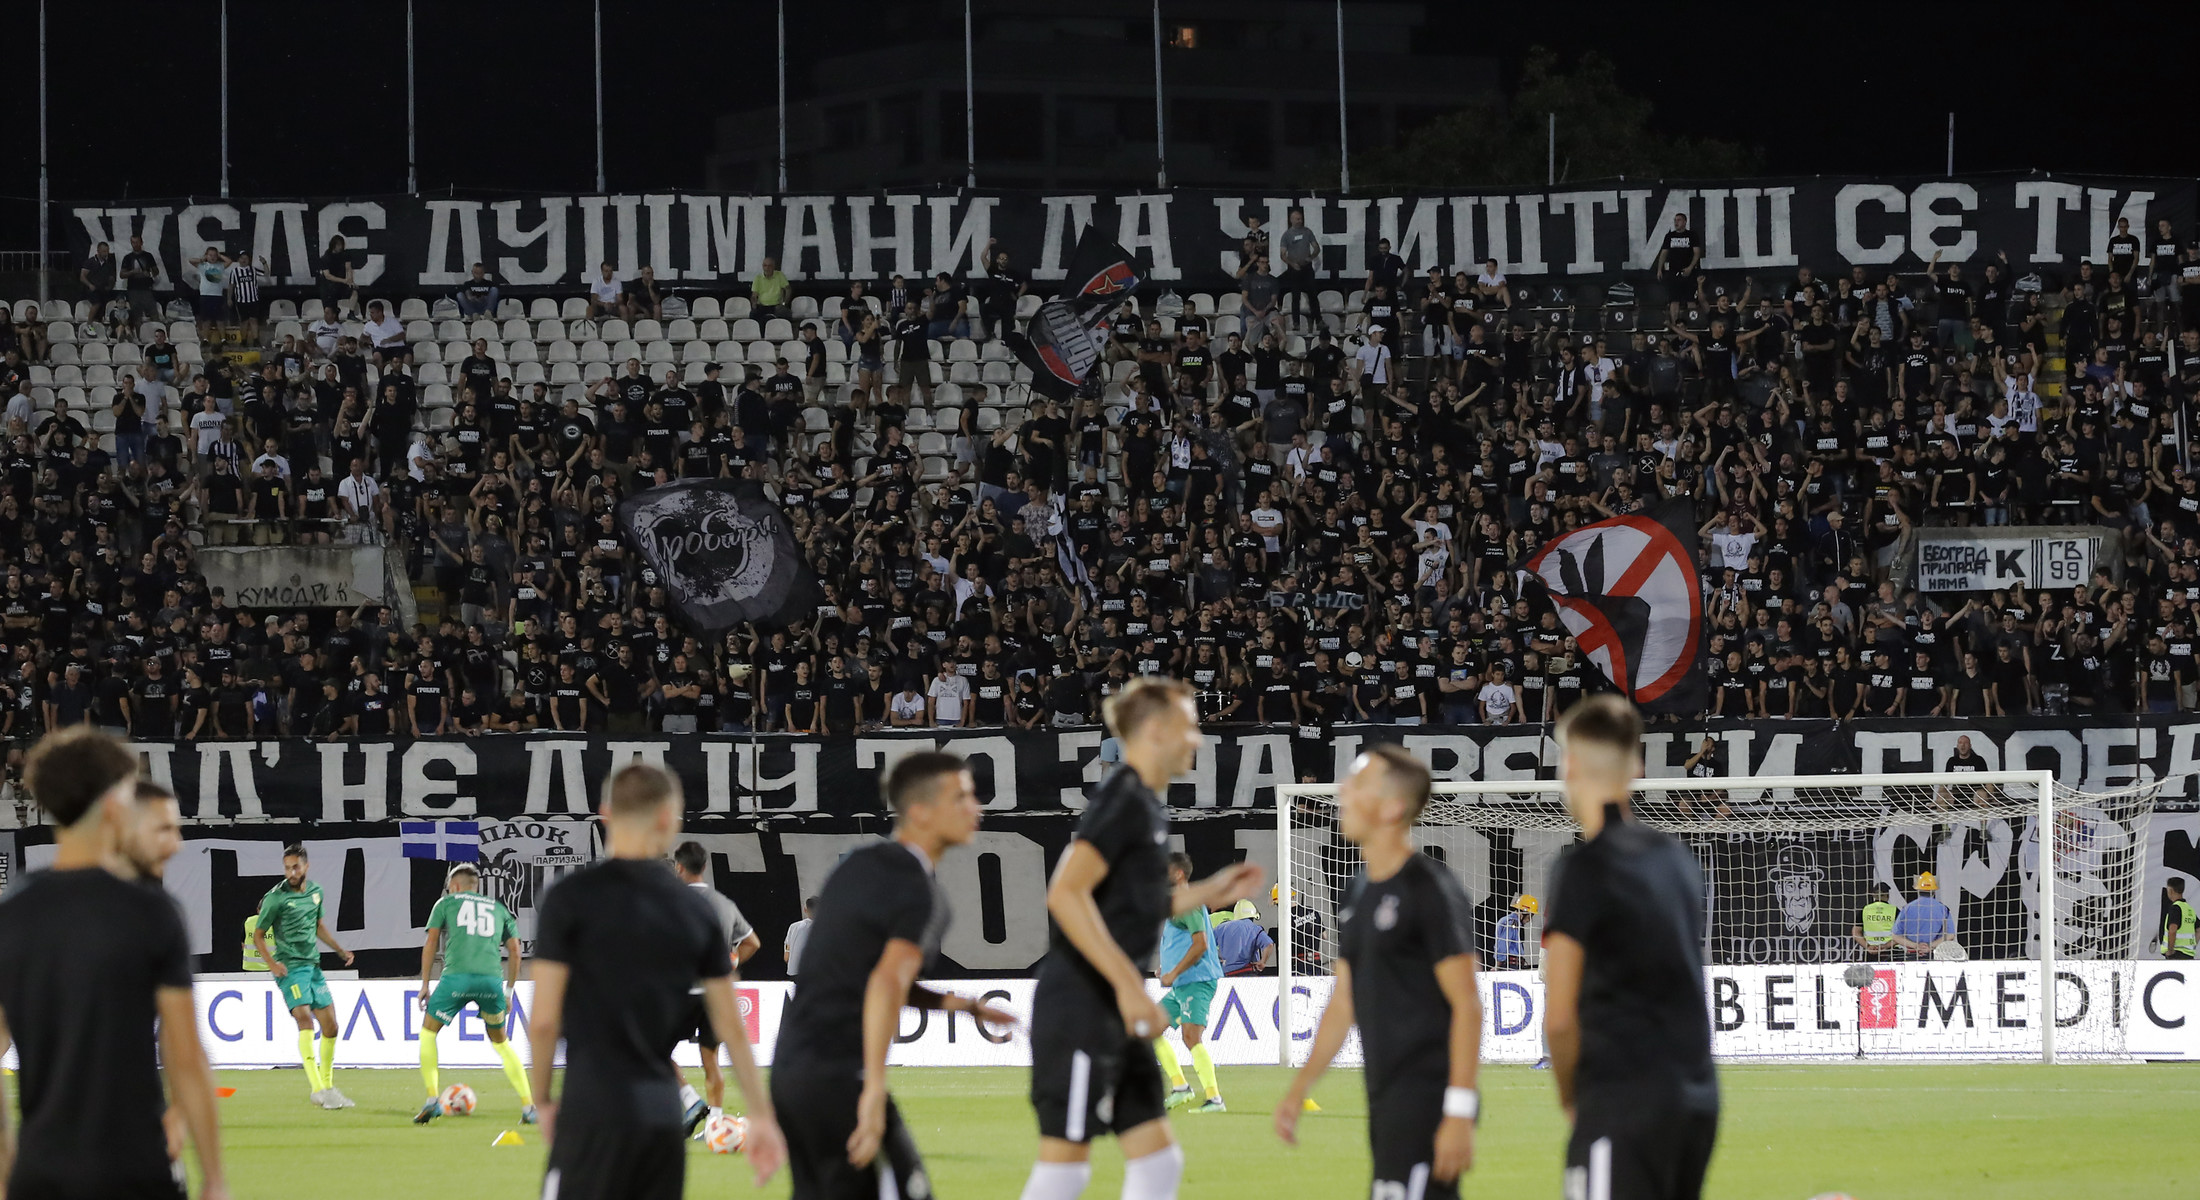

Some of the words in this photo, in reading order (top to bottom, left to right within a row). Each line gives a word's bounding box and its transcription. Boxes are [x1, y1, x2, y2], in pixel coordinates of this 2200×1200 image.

[1923, 545, 1991, 563] БЕОГРАД
[1921, 561, 1986, 576] ПРИПАДА
[2051, 561, 2080, 580] 99
[1928, 577, 1968, 589] НАМА
[523, 740, 822, 814] ДЈУ
[536, 855, 583, 865] ПАРТИЗАН
[457, 900, 496, 938] 45
[1713, 975, 1841, 1032] BEL
[1918, 971, 2187, 1030] MEDIC
